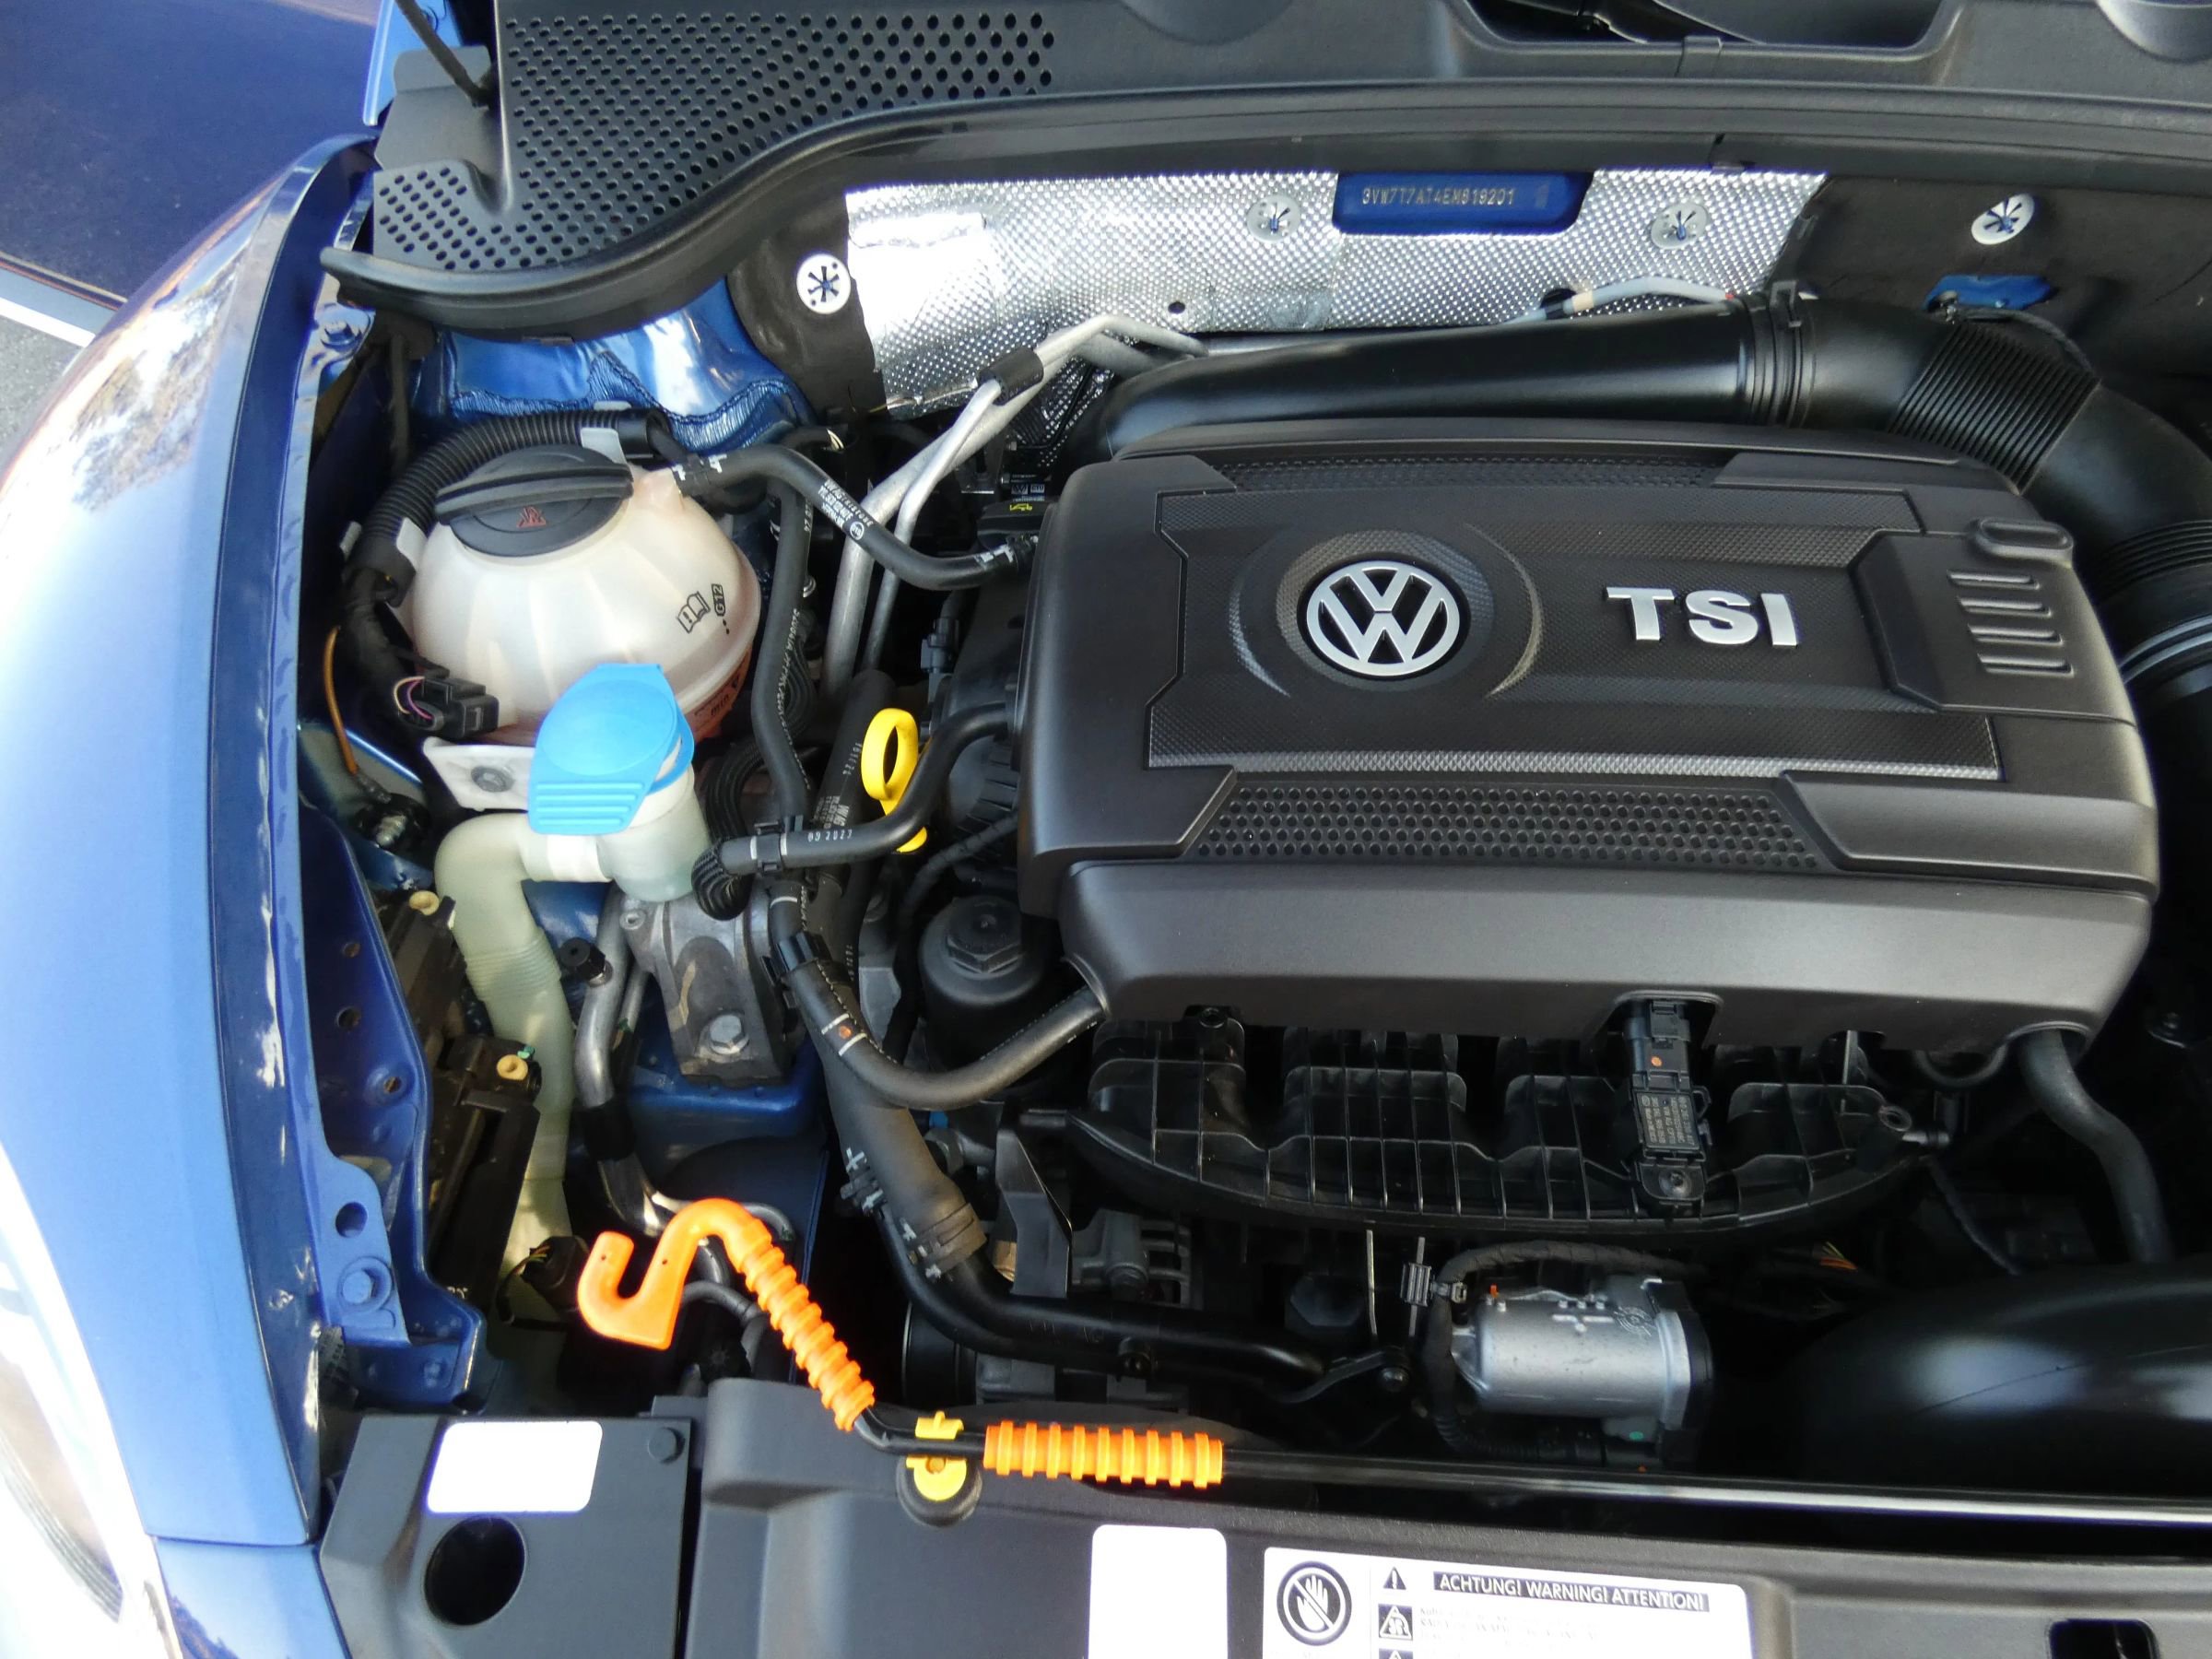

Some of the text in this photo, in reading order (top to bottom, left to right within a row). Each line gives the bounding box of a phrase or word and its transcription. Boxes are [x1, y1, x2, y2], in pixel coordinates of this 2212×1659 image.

[712, 584, 725, 615] G12
[1307, 560, 1460, 677] VW
[1606, 587, 1798, 647] TSI
[1440, 1574, 1704, 1611] ACHTUNG! WARNING! ATTENTION!
